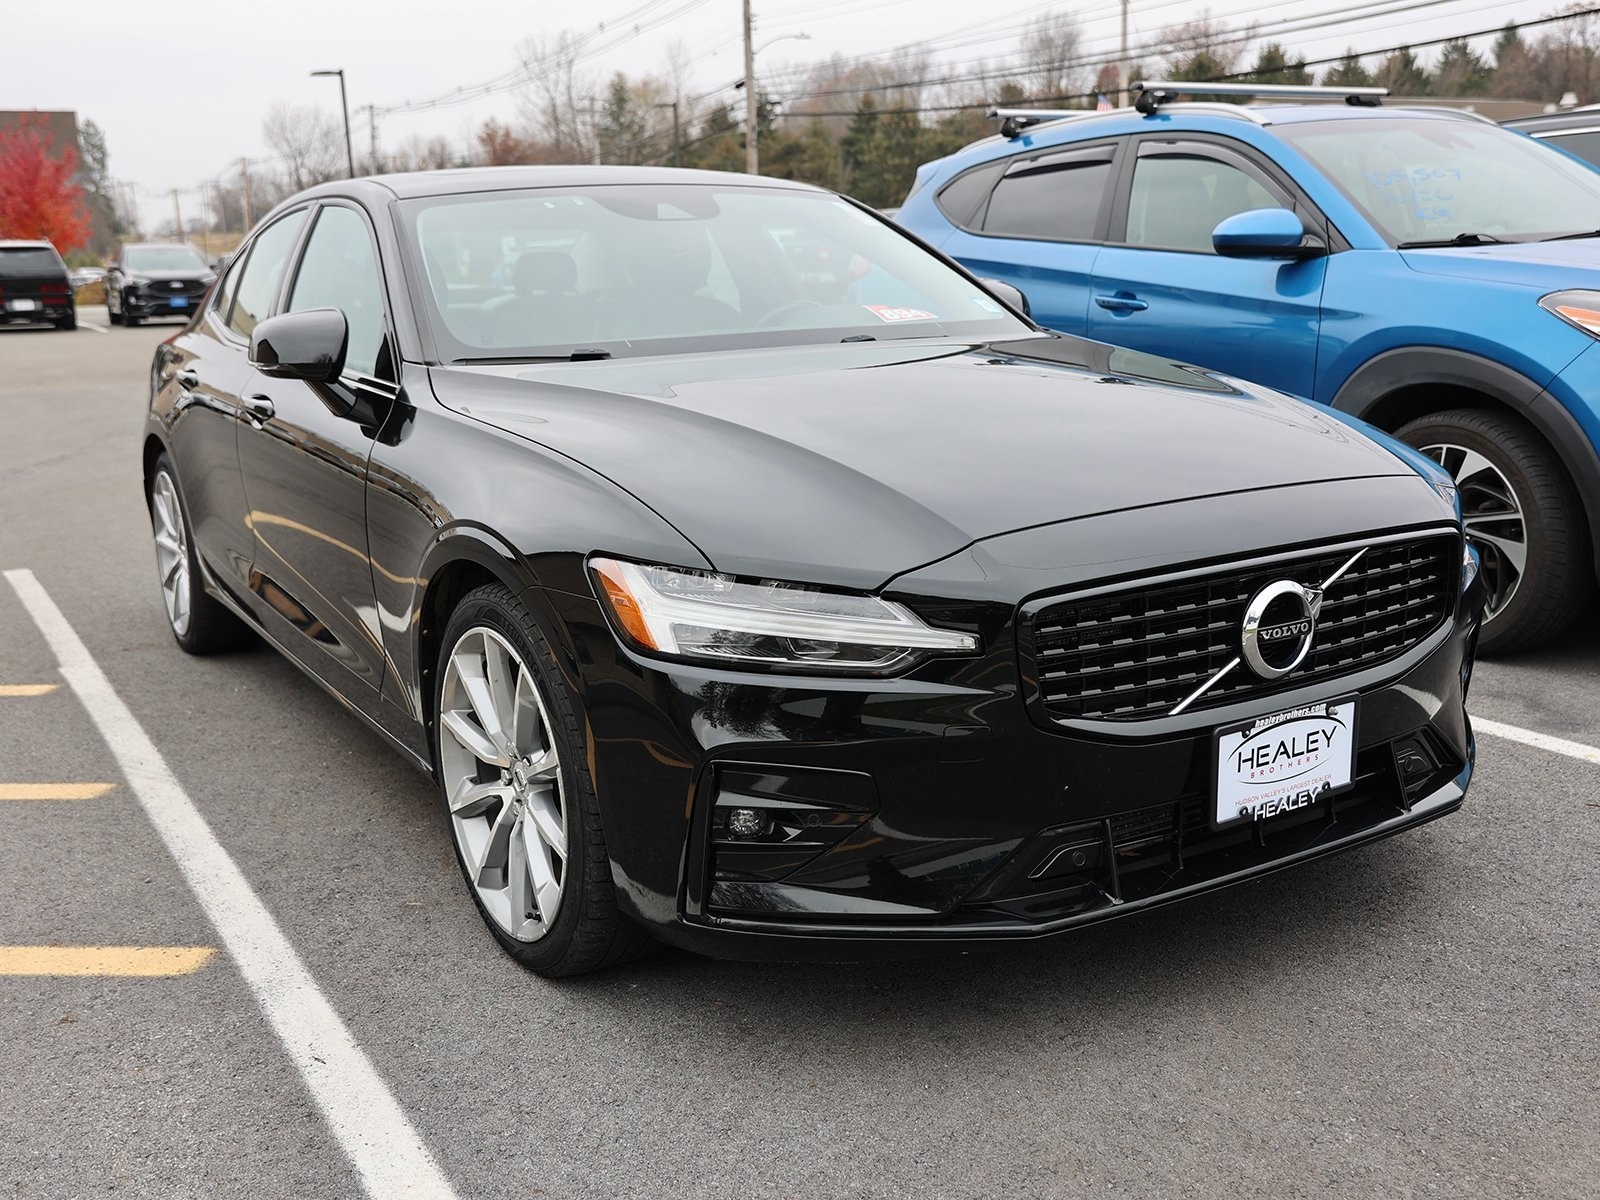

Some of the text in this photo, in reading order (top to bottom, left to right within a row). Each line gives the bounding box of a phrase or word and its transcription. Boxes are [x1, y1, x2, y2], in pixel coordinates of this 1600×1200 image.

[1260, 622, 1309, 639] VOLVO
[1237, 725, 1337, 773] HEALEY
[1250, 754, 1319, 779] BROTHERS
[1235, 773, 1332, 806] HUDSON VALLEY'S LARGEST DEALER
[1254, 786, 1319, 821] HEALEY
